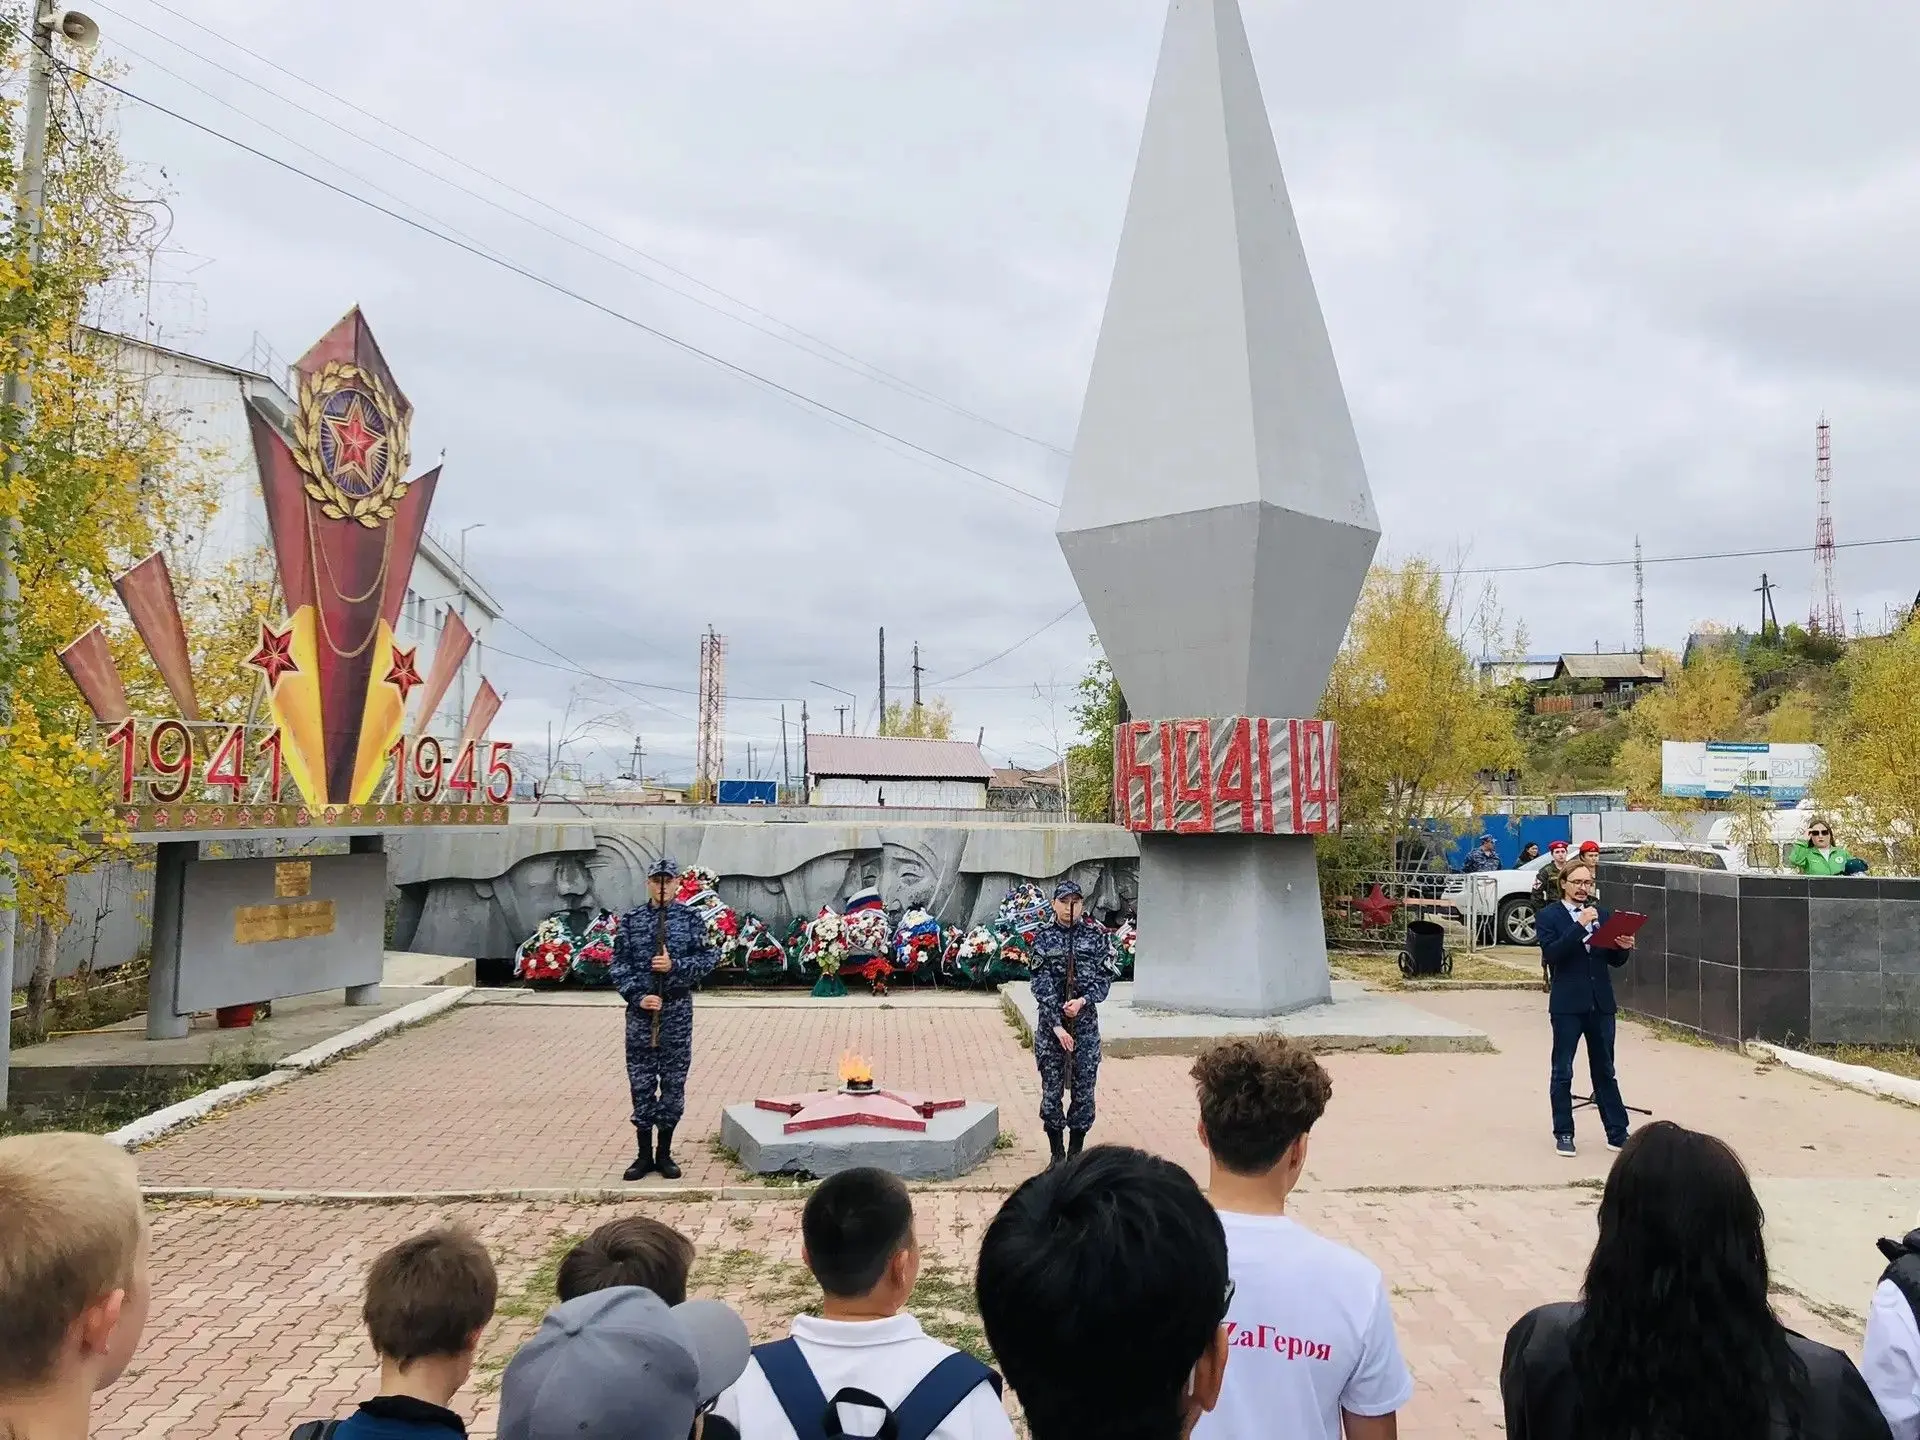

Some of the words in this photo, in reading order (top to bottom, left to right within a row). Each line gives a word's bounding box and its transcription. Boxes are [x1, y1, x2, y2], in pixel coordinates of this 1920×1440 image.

[106, 717, 283, 804] 1941
[388, 735, 514, 804] 1945
[1160, 717, 1274, 832] 1941
